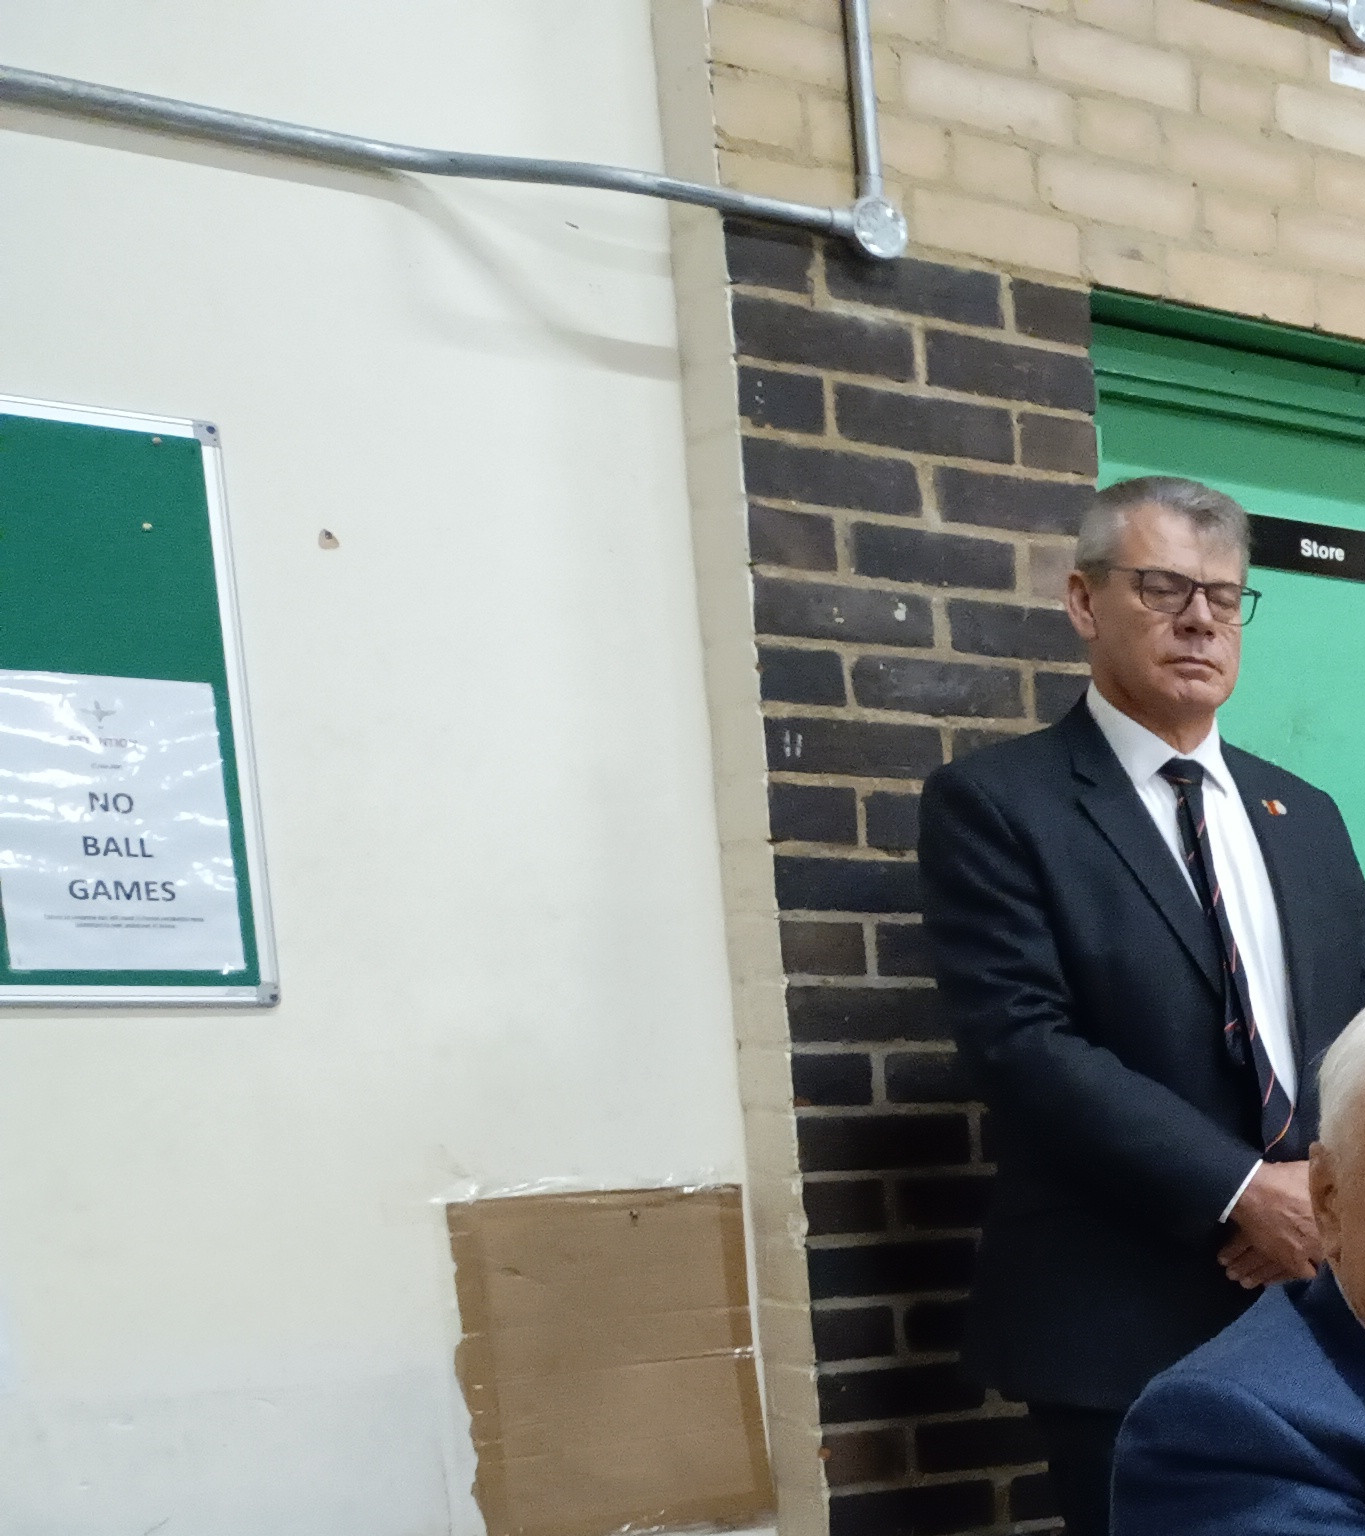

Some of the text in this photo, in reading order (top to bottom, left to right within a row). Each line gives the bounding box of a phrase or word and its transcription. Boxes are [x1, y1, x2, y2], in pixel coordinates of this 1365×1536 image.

[1300, 538, 1345, 562] Store
[88, 791, 134, 815] NO
[82, 835, 154, 858] BALL
[68, 879, 176, 902] GAMES
